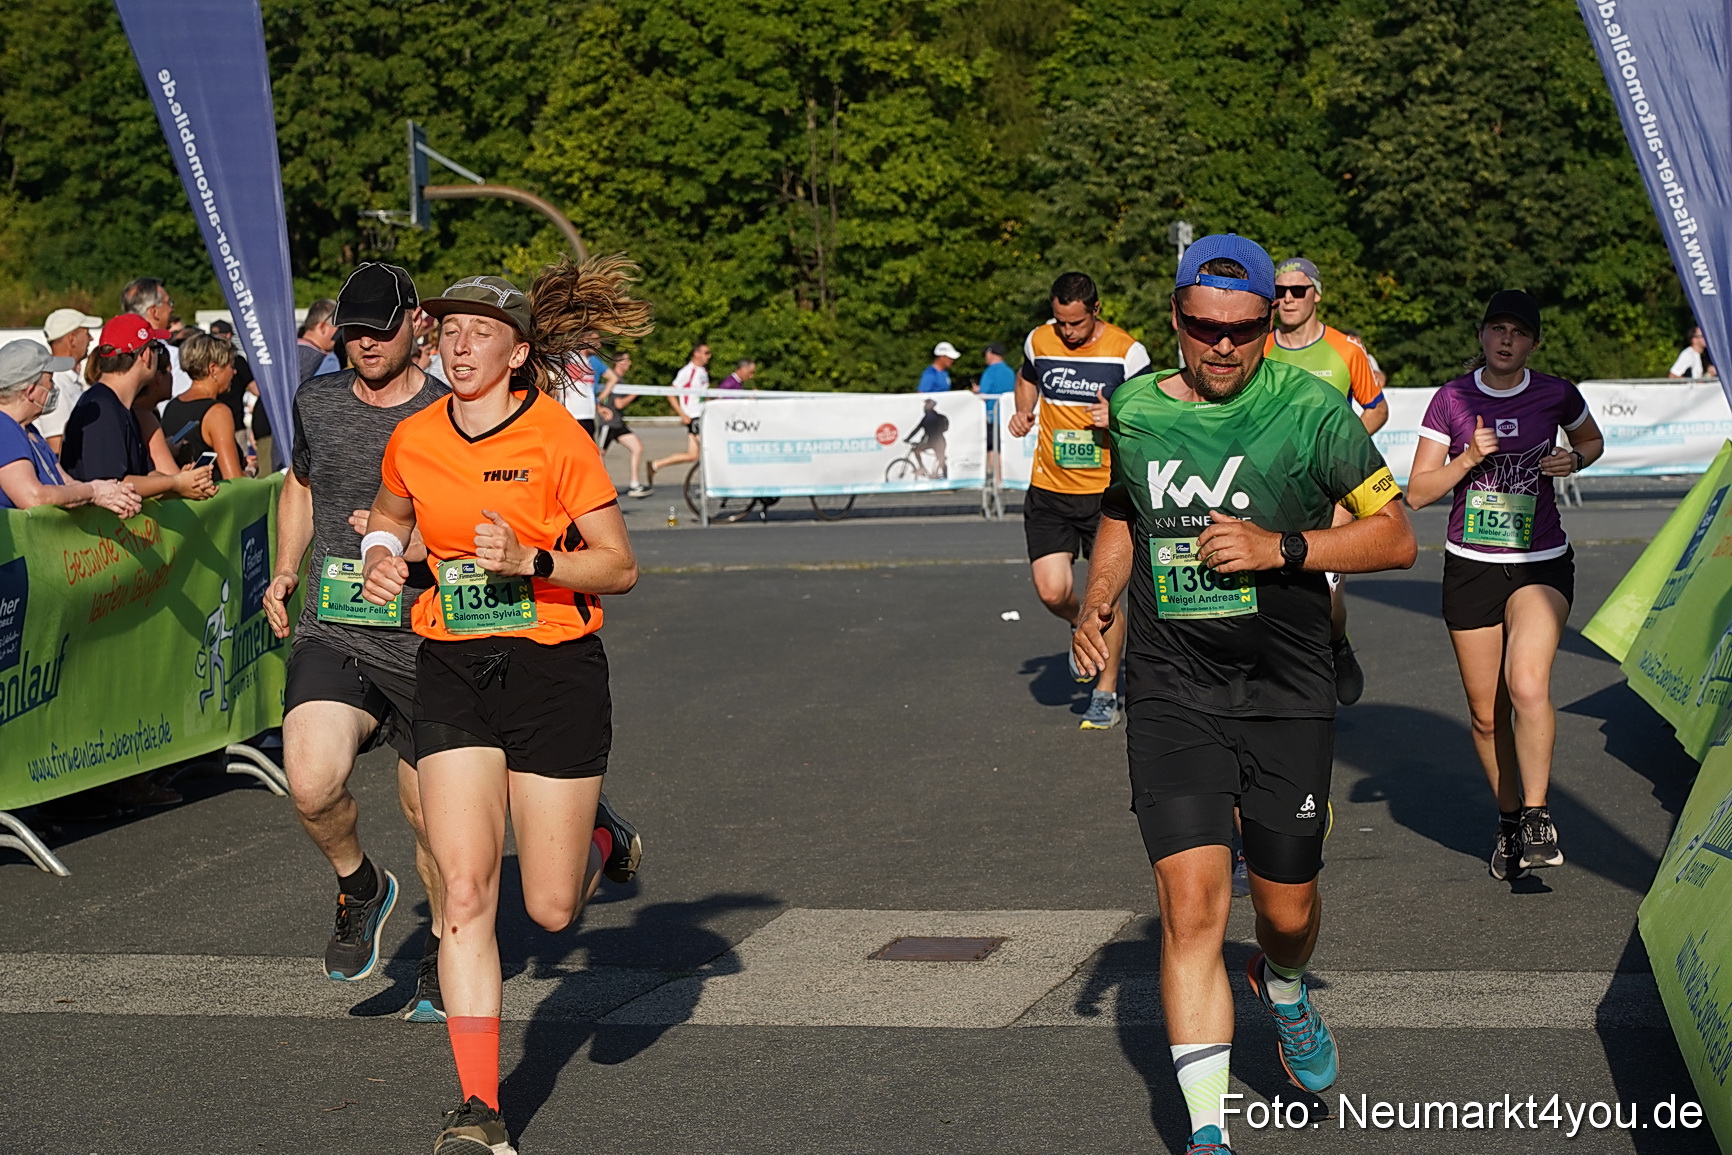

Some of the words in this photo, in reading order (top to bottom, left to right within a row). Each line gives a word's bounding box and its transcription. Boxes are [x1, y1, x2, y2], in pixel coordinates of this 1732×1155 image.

[1051, 376, 1106, 392] Fischer
[1602, 403, 1638, 416] NOW
[725, 420, 760, 433] NOW
[1060, 443, 1095, 456] 1869
[483, 469, 530, 482] THULE
[1155, 516, 1176, 529] KW
[1467, 514, 1475, 533] RUN
[1476, 509, 1524, 531] 1526
[1478, 528, 1501, 537] Niebler
[1523, 517, 1532, 542] 2022
[322, 585, 330, 609] RUN
[453, 582, 514, 610] 1381
[1157, 575, 1169, 603] RUN
[328, 601, 368, 614] Mühlbauer
[369, 606, 389, 615] Felix
[444, 594, 455, 620] RUN
[518, 584, 532, 619] 2022
[1168, 594, 1196, 607] Weigel
[1198, 593, 1241, 605] Andreas
[454, 612, 491, 621] Salomon
[492, 609, 522, 620] Sylvia
[27, 713, 173, 783] www.firmenlauf-oberpfalz.de
